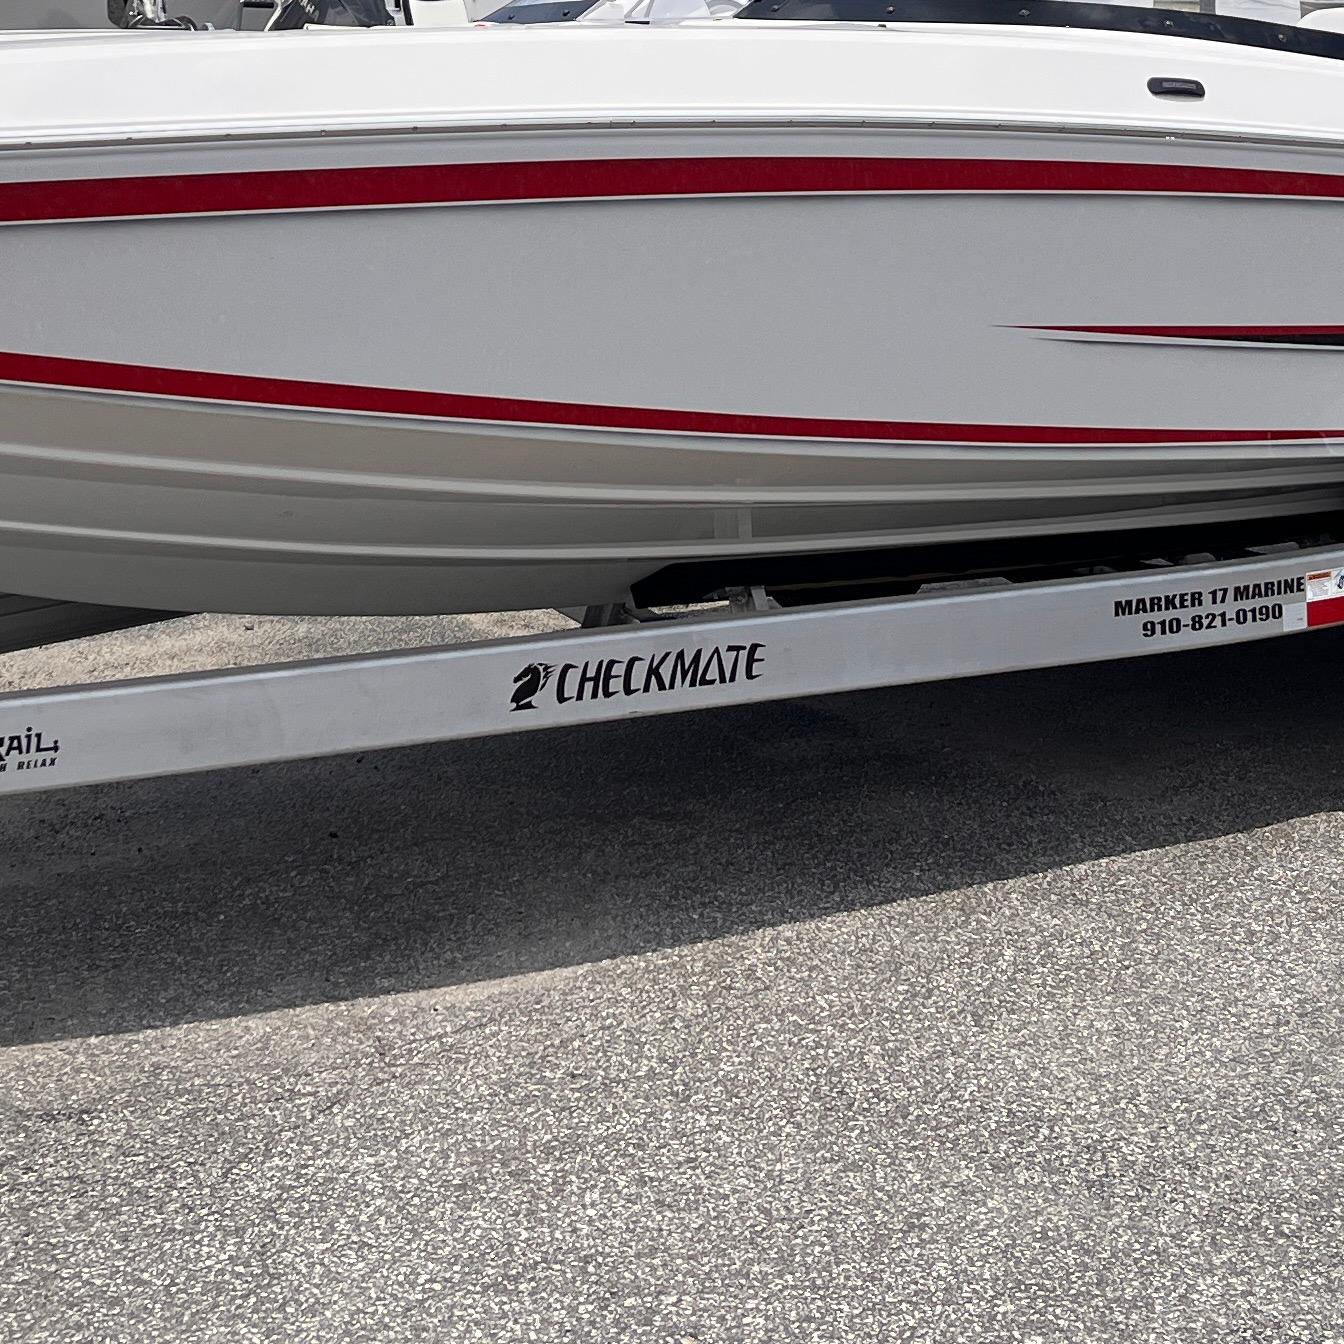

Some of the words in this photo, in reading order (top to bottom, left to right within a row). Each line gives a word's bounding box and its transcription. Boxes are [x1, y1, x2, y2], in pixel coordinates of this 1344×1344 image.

[1114, 591, 1203, 617] MARKER
[1208, 587, 1229, 606] 17
[1233, 576, 1305, 601] MARINE
[1142, 603, 1283, 638] 910-821-0190
[556, 642, 766, 704] CHECKMATE
[17, 757, 58, 771] RELAX
